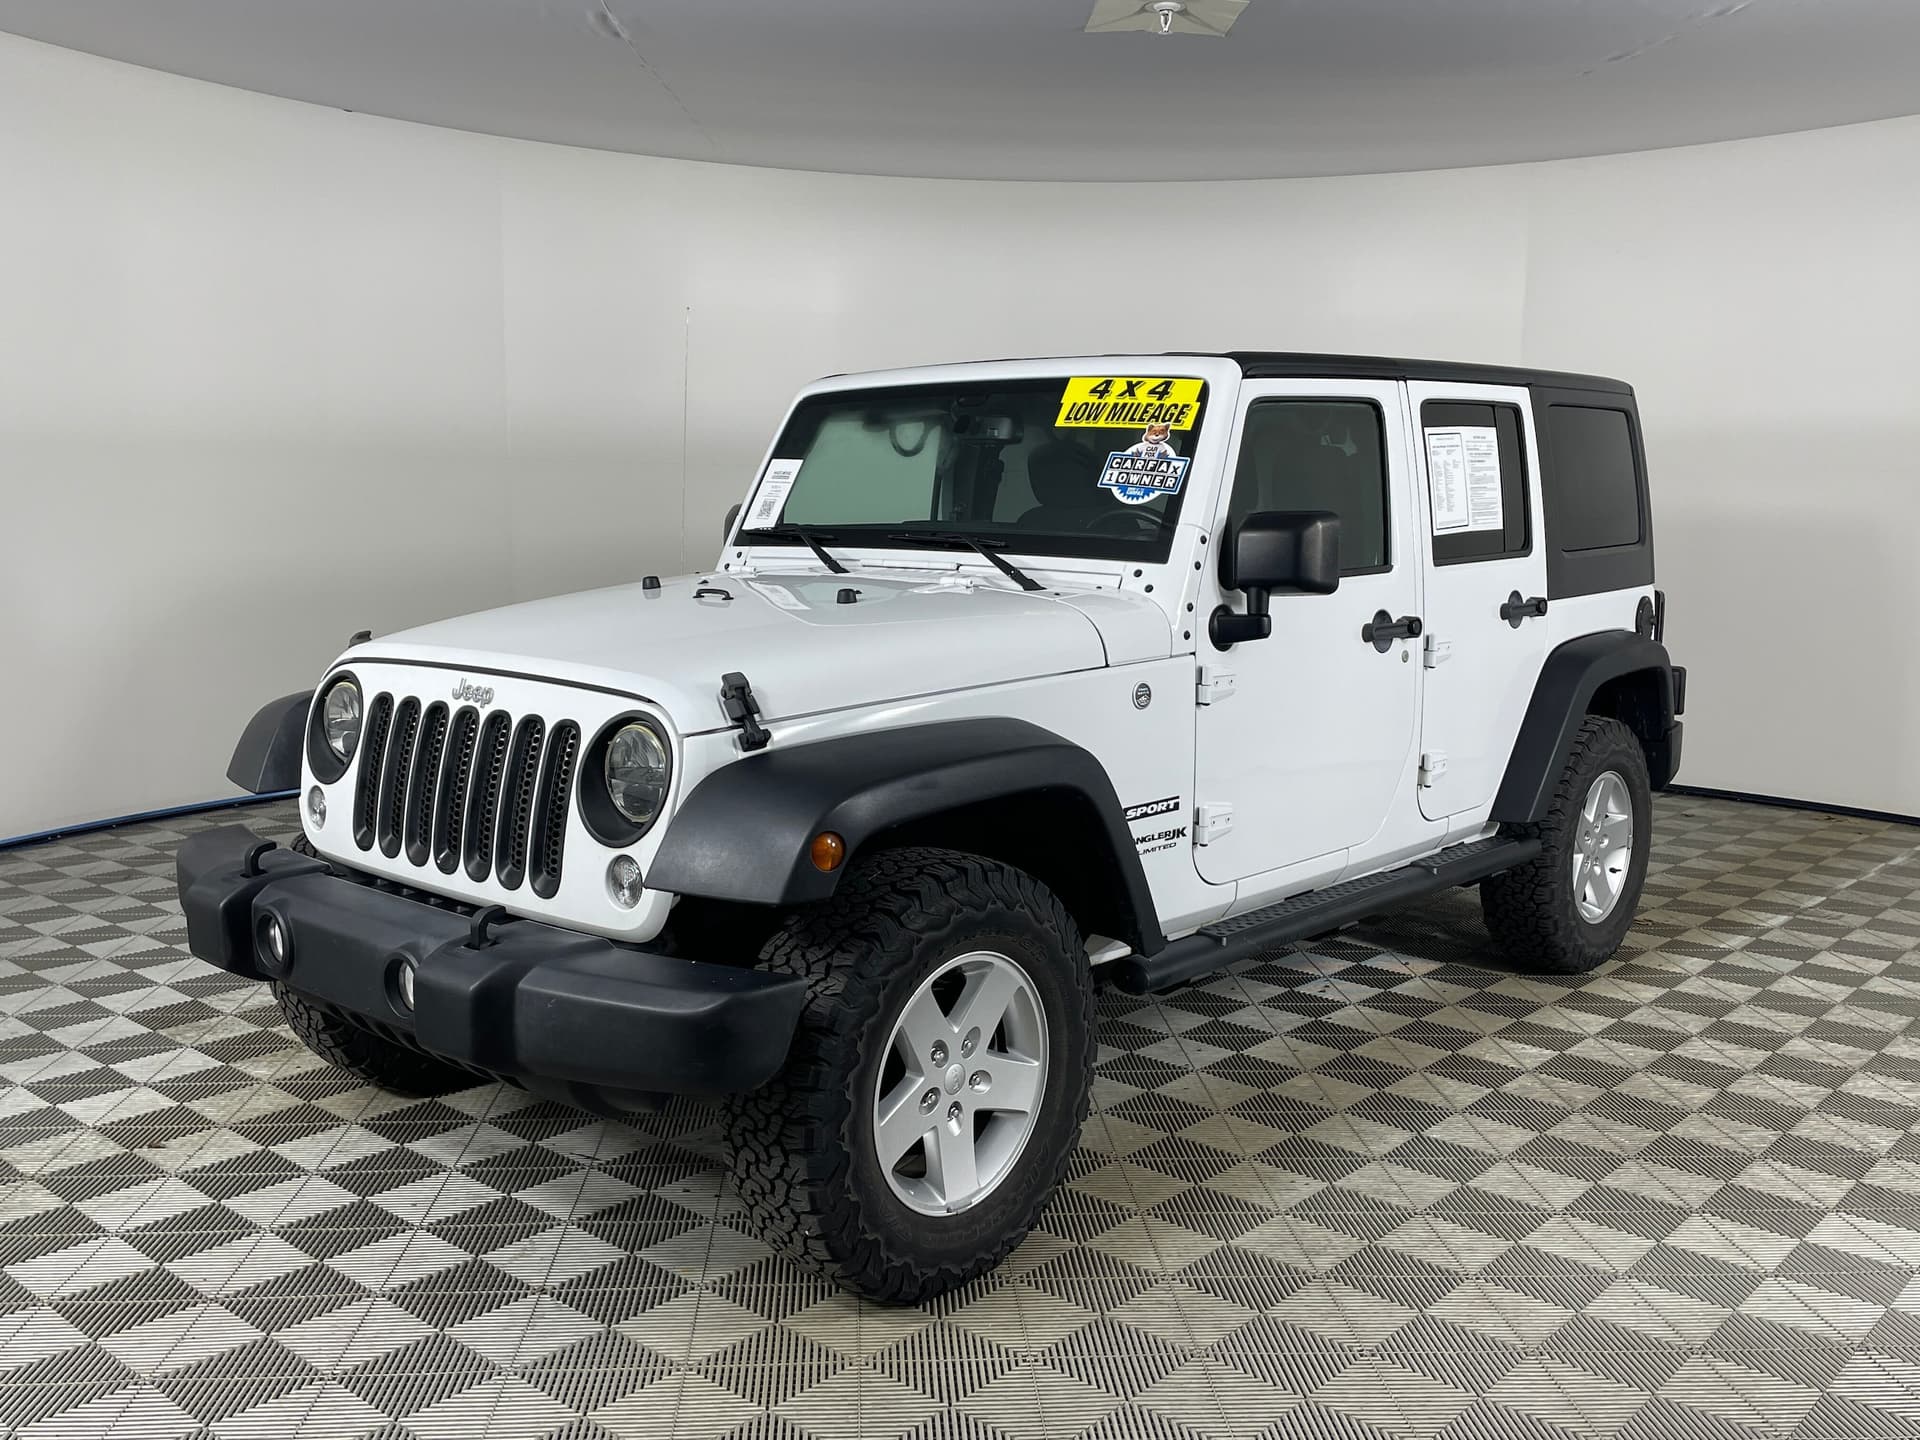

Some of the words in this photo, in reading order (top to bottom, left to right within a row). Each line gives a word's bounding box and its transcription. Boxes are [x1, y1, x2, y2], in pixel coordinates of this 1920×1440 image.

[1063, 401, 1109, 423] LOW
[1103, 401, 1192, 426] MILEAGE
[1111, 458, 1181, 475] CARFAX
[1117, 472, 1177, 488] OWNER
[451, 677, 495, 709] Jeep
[1125, 799, 1180, 819] SPORT
